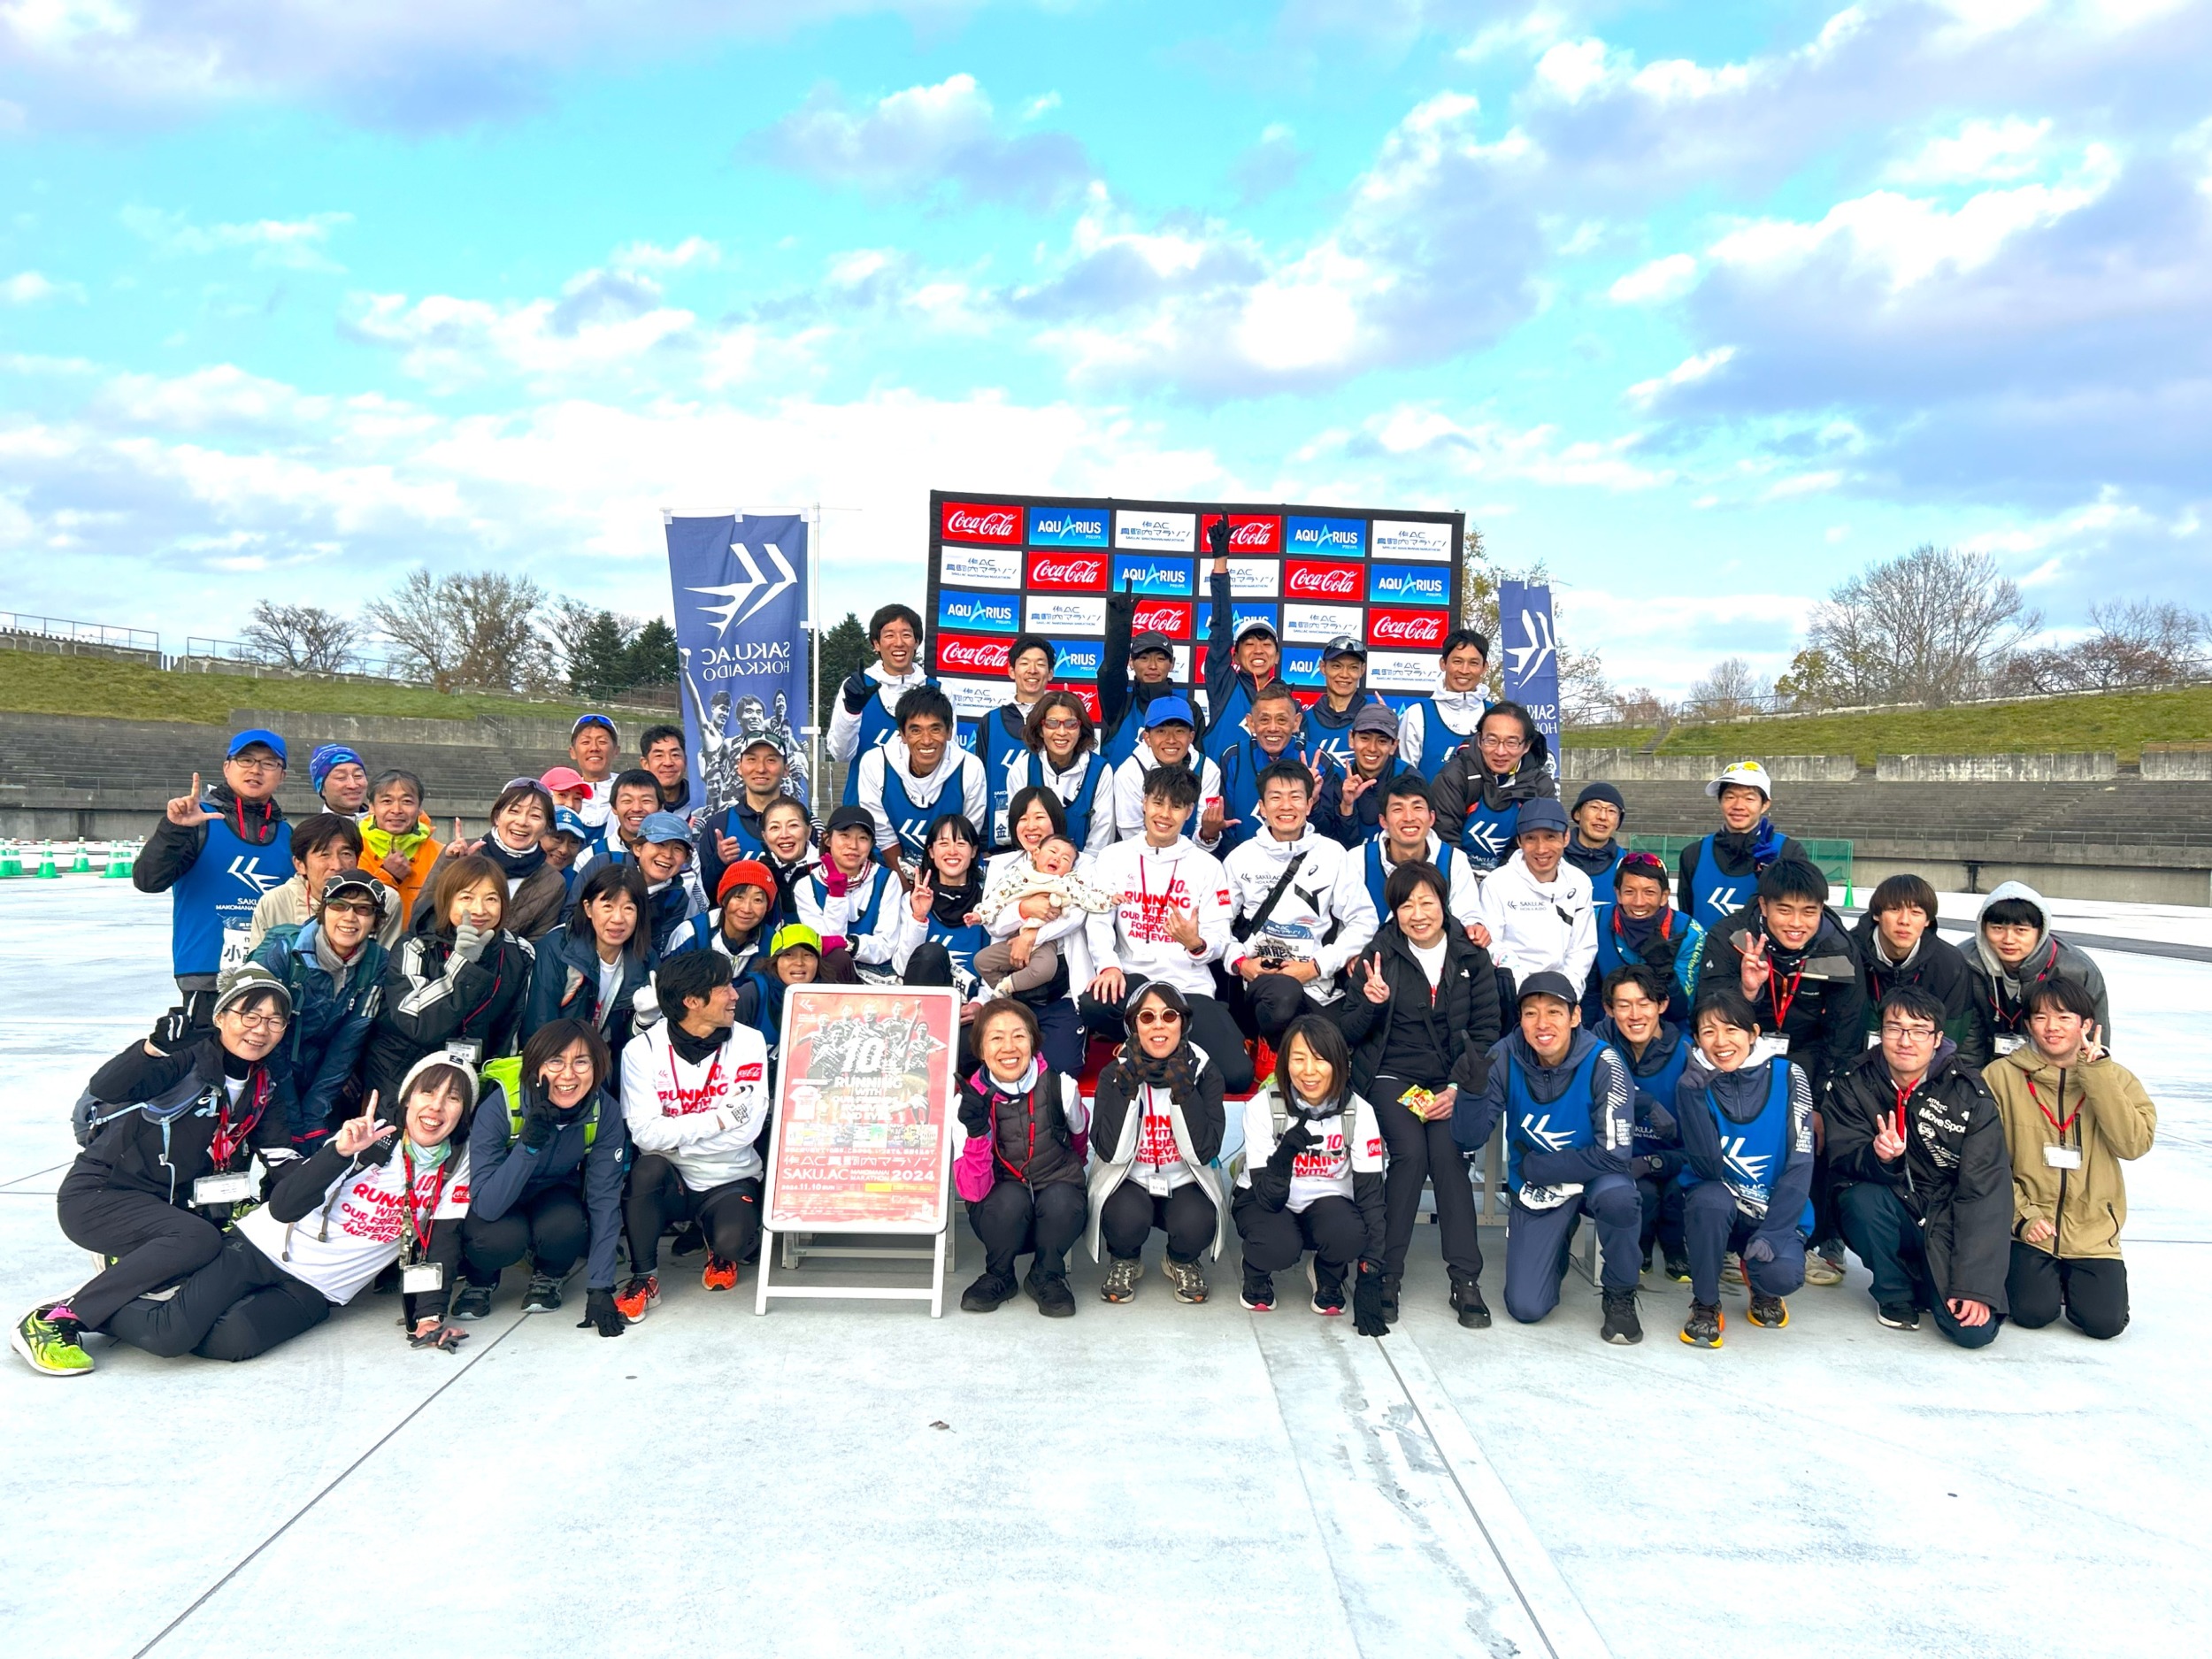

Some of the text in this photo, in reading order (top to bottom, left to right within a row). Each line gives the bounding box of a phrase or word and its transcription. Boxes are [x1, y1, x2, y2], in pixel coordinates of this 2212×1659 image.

[948, 510, 1018, 537] Coca-Cola
[1037, 514, 1102, 539] AQUARIUS
[1294, 524, 1358, 549] AQUARIUS
[1033, 559, 1102, 583] Coca-Cola
[1122, 563, 1186, 588] AQUARIUS
[1290, 568, 1358, 593] Coca-Cola
[1378, 572, 1443, 597] AQUARIUS
[947, 599, 1012, 623] AQUARIUS
[1373, 616, 1443, 640] Coca-Cola
[1054, 647, 1096, 670] ARIUS
[1120, 910, 1140, 920] OUR
[834, 1076, 903, 1089] RUNNING
[1326, 1134, 1343, 1150] 10
[415, 1175, 437, 1192] 10
[782, 1168, 935, 1182] SAKU.AC 2024
[342, 1202, 368, 1223] OUR
[368, 1234, 396, 1244] EVE
